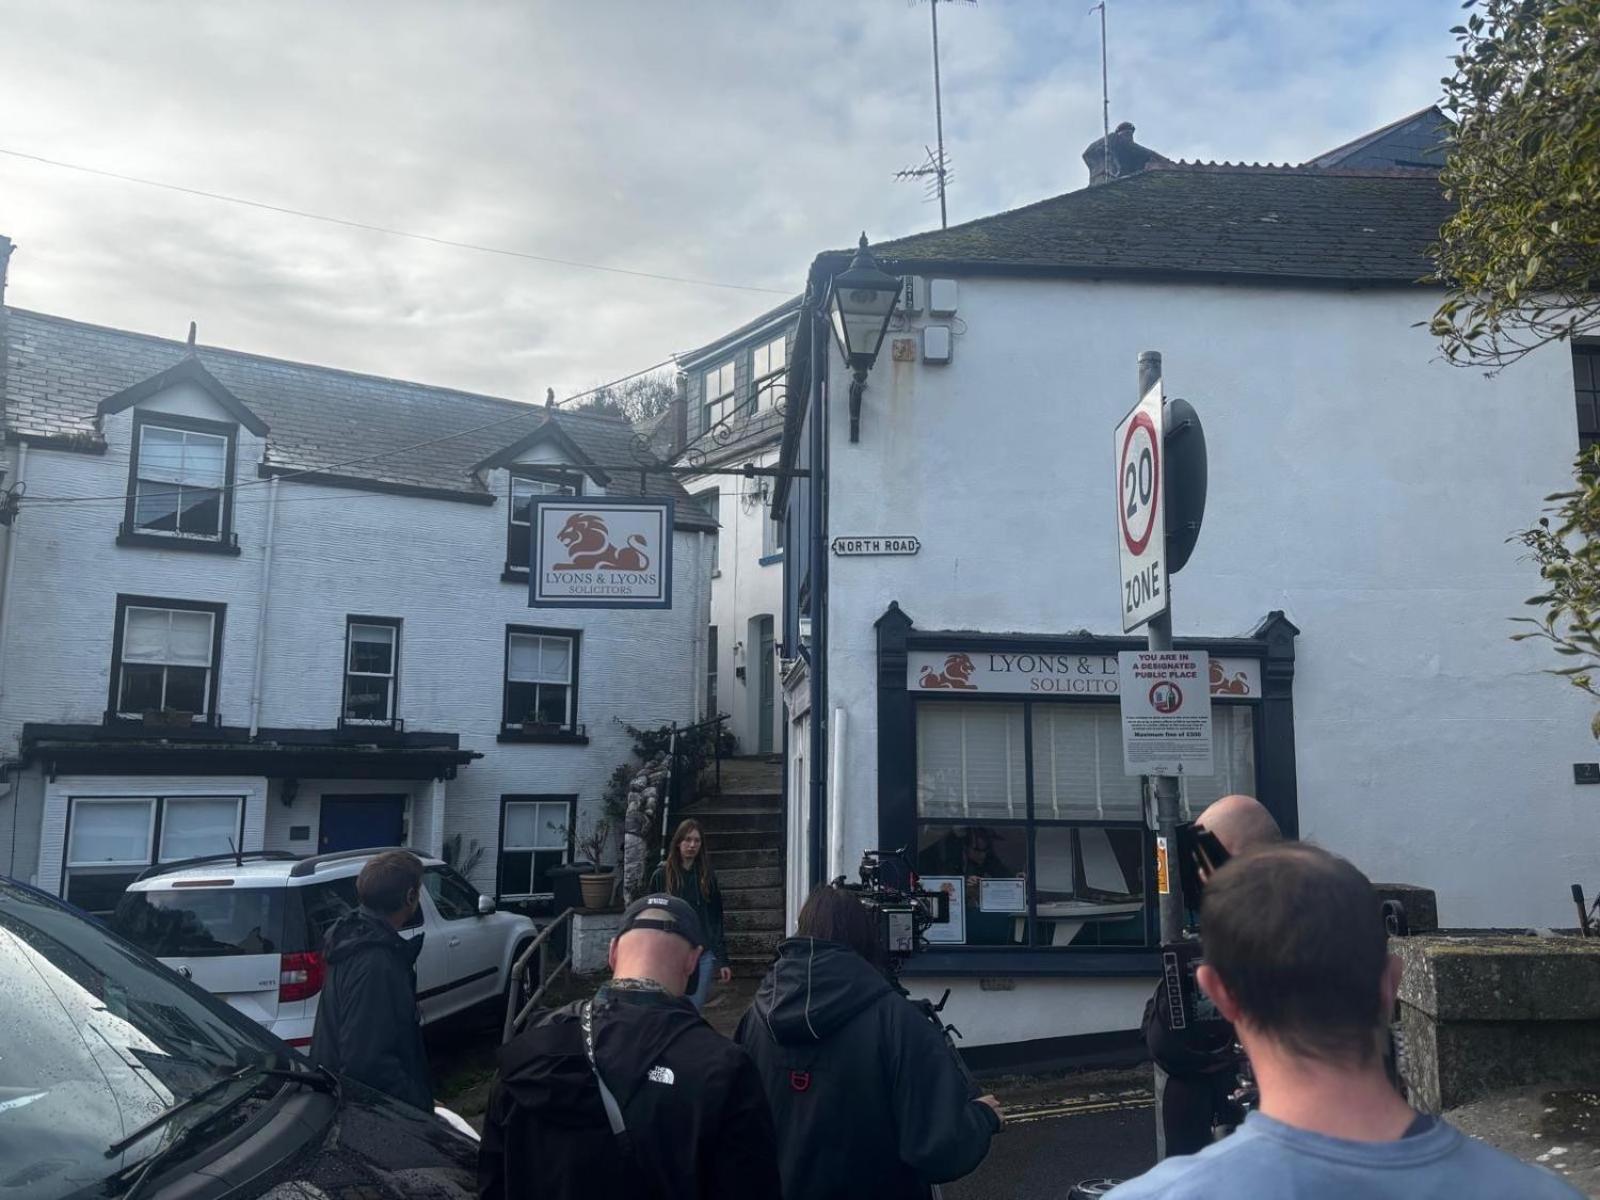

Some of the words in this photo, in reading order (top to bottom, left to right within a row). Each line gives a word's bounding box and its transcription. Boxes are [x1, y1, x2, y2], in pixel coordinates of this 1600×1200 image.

[1125, 447, 1152, 519] 20
[838, 541, 880, 552] NORTH
[884, 540, 915, 551] ROAD
[545, 572, 592, 585] LYONS
[596, 574, 606, 585] &
[610, 573, 657, 585] LYONS
[568, 585, 633, 595] SOLICITORS
[1125, 561, 1160, 613] ZONE
[989, 654, 1069, 674] LYONS
[1077, 656, 1093, 675] &
[1135, 671, 1167, 679] PUBLIC
[1169, 671, 1198, 679] PLACE
